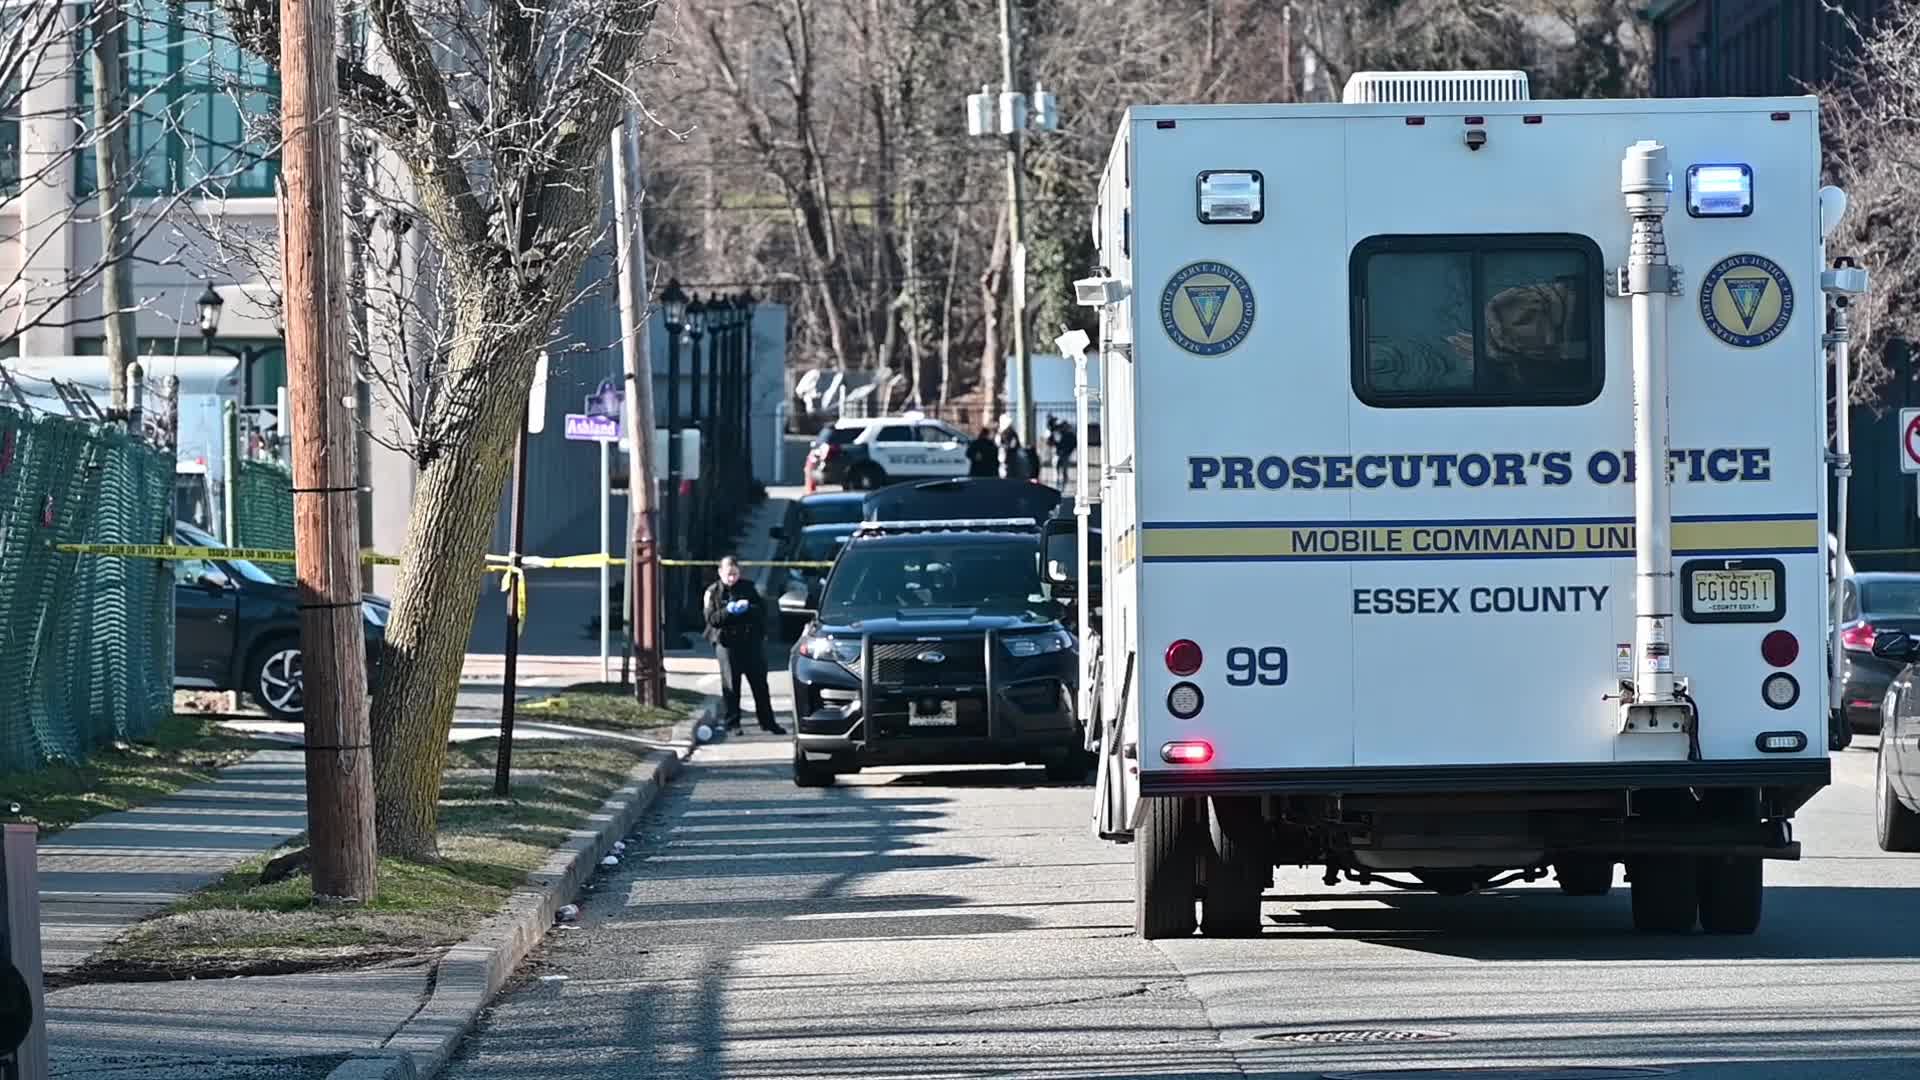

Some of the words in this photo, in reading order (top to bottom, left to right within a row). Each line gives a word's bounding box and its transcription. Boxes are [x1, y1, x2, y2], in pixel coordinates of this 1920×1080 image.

[1176, 264, 1208, 281] SERVE
[1716, 257, 1746, 273] SERVE
[567, 419, 616, 435] Ashland
[1188, 452, 1573, 489] PROSECUTOR'S
[1291, 529, 1403, 552] MOBILE
[1412, 527, 1576, 551] COMMAND
[1586, 526, 1636, 549] UNI
[1353, 587, 1460, 614] ESSEX
[1470, 586, 1609, 613] COUNTY
[1697, 581, 1768, 602] CG19511
[1226, 646, 1288, 686] 99
